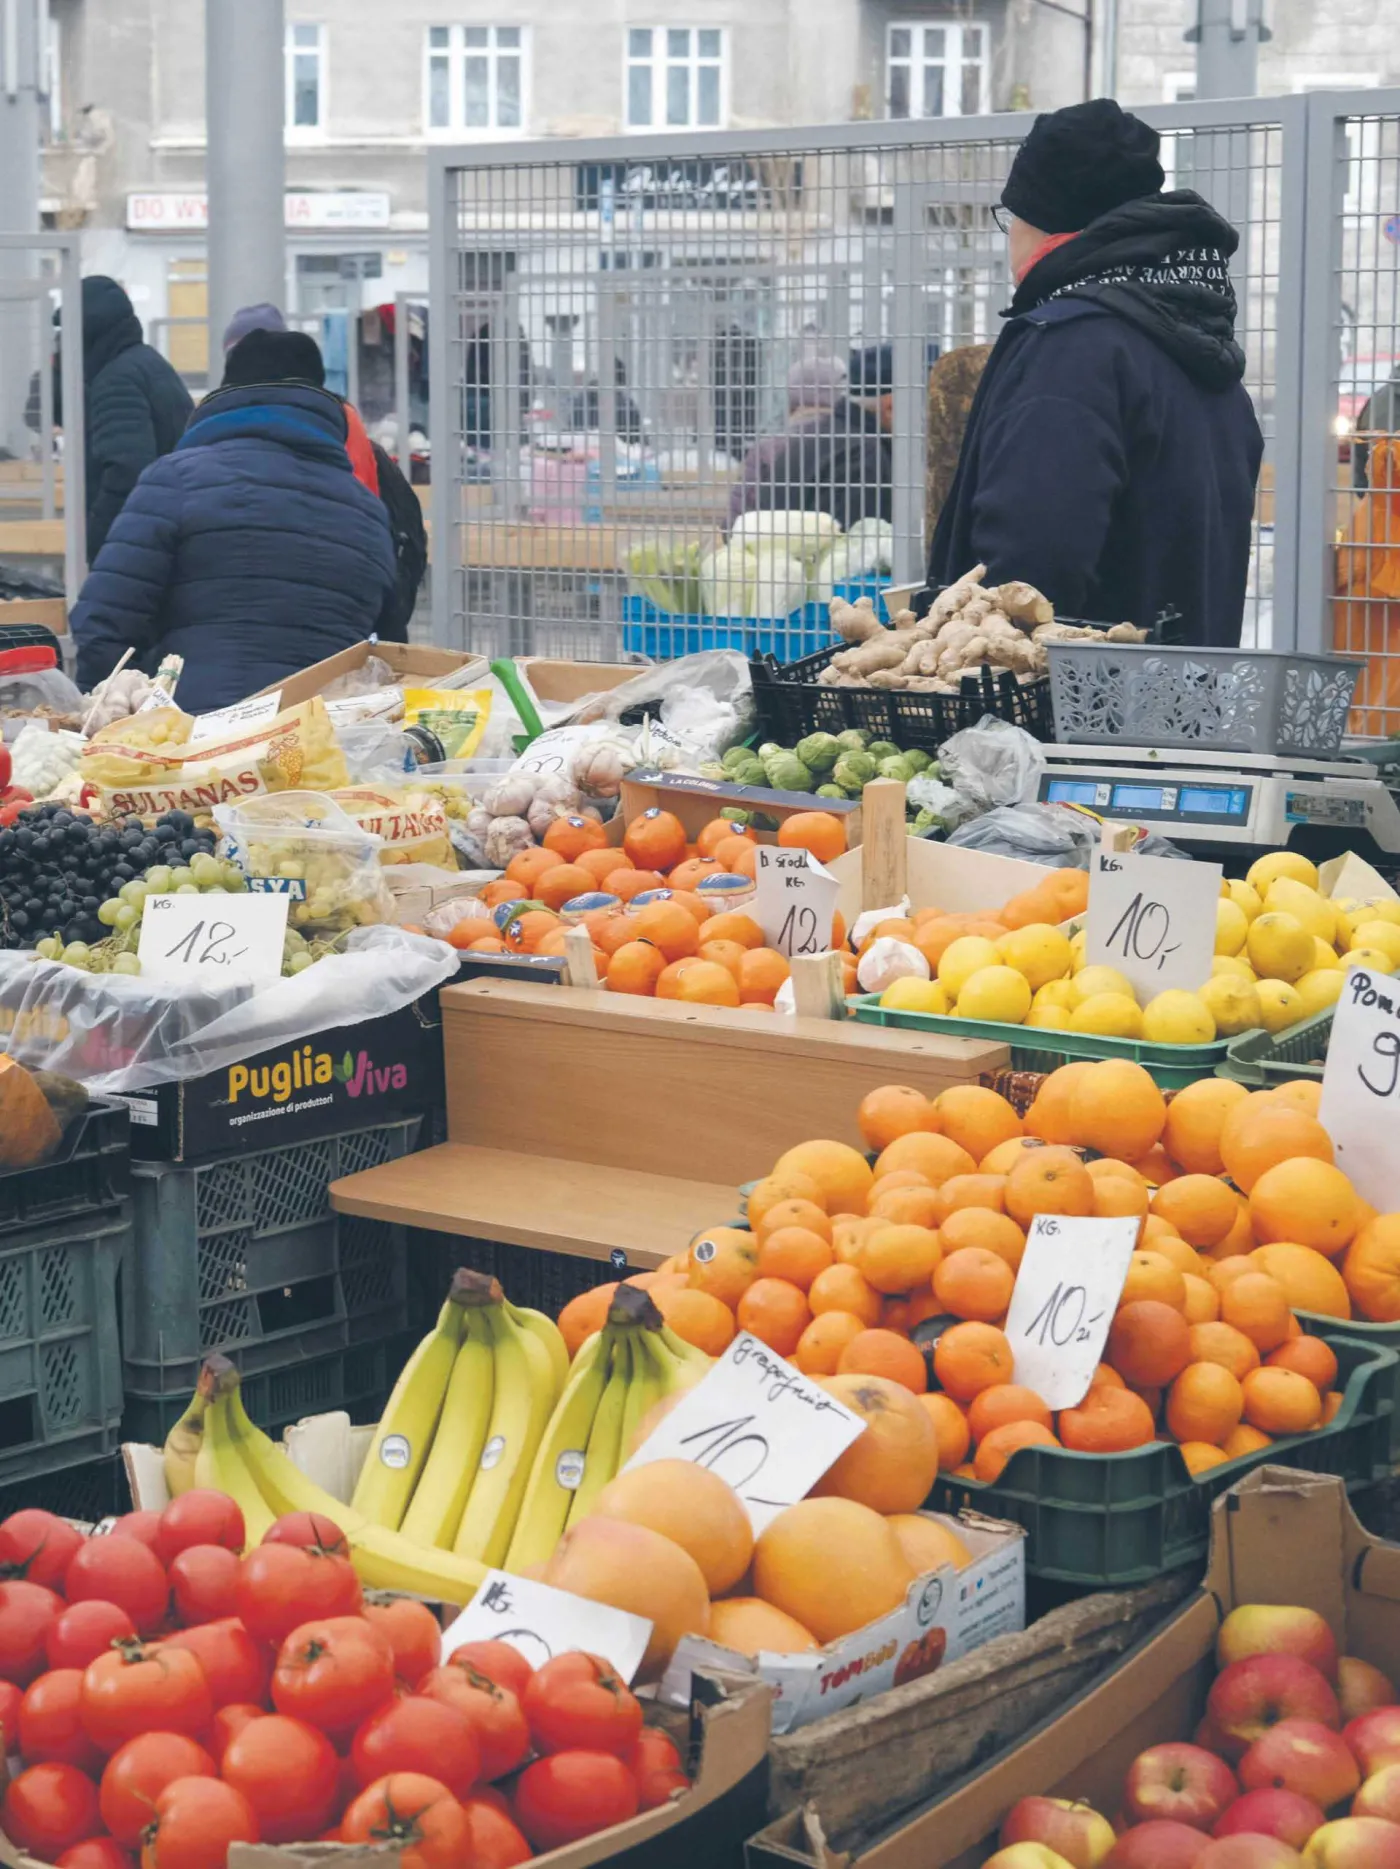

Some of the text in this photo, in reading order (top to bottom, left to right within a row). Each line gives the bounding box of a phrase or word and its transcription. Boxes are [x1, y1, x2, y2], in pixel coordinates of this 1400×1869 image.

[112, 771, 259, 815] SULTANAS
[229, 1045, 407, 1104] Puglia Viva
[229, 1093, 333, 1127] organizzazione di produttori
